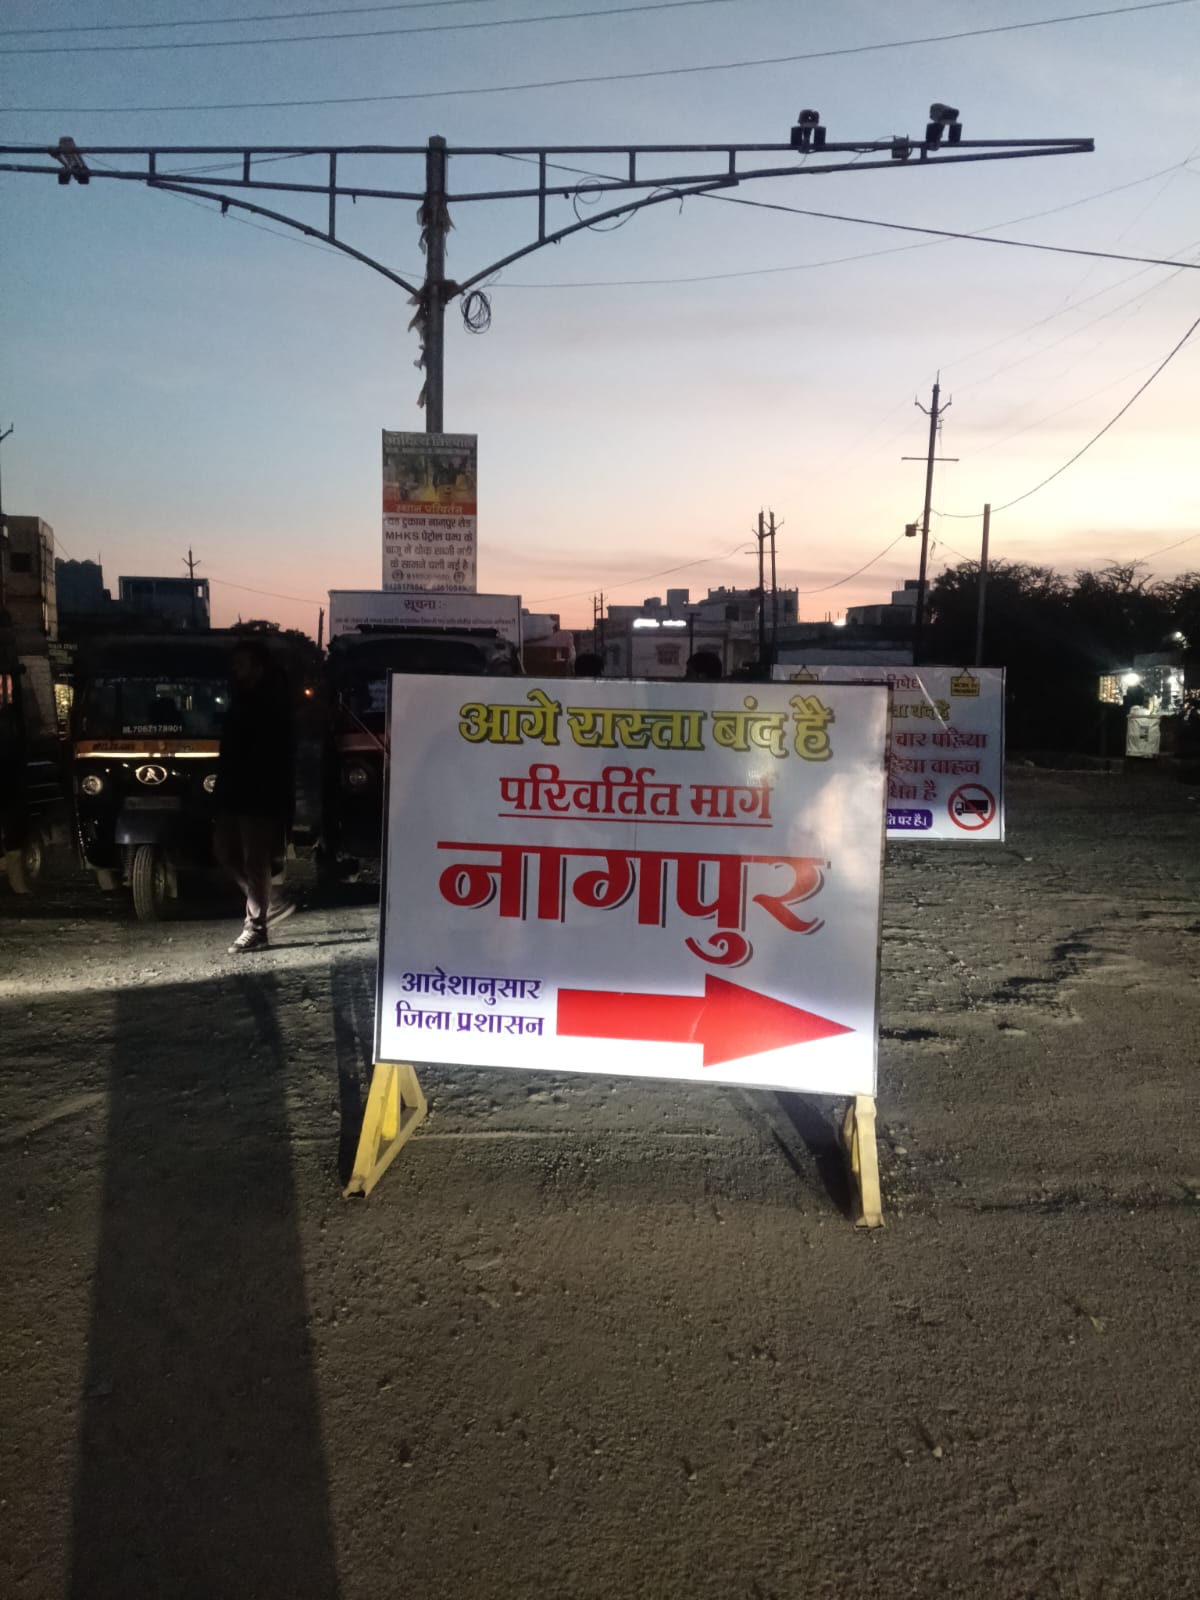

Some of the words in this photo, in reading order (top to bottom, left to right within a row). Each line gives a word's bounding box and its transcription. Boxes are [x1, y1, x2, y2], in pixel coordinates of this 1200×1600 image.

[402, 517, 426, 529] दुकान
[385, 530, 419, 541] MHKS
[421, 530, 443, 543] पेट्रोल
[401, 559, 426, 570] सामने
[403, 599, 436, 613] सूचना
[459, 688, 563, 746] आगे
[566, 707, 708, 751] रास्ता
[711, 695, 790, 759] बंद
[789, 694, 836, 762] है
[895, 732, 927, 748] चार
[931, 726, 988, 749] पहिया
[931, 759, 981, 776] वाहन
[499, 763, 682, 817] परिवर्तित
[689, 774, 774, 819] मार्ग
[922, 779, 938, 802] है
[897, 815, 912, 827] पर
[436, 841, 831, 968] नागपुर
[401, 966, 542, 1006] आदेशानुसार
[395, 1000, 451, 1030] जिला
[456, 1012, 545, 1036] प्रशासन
